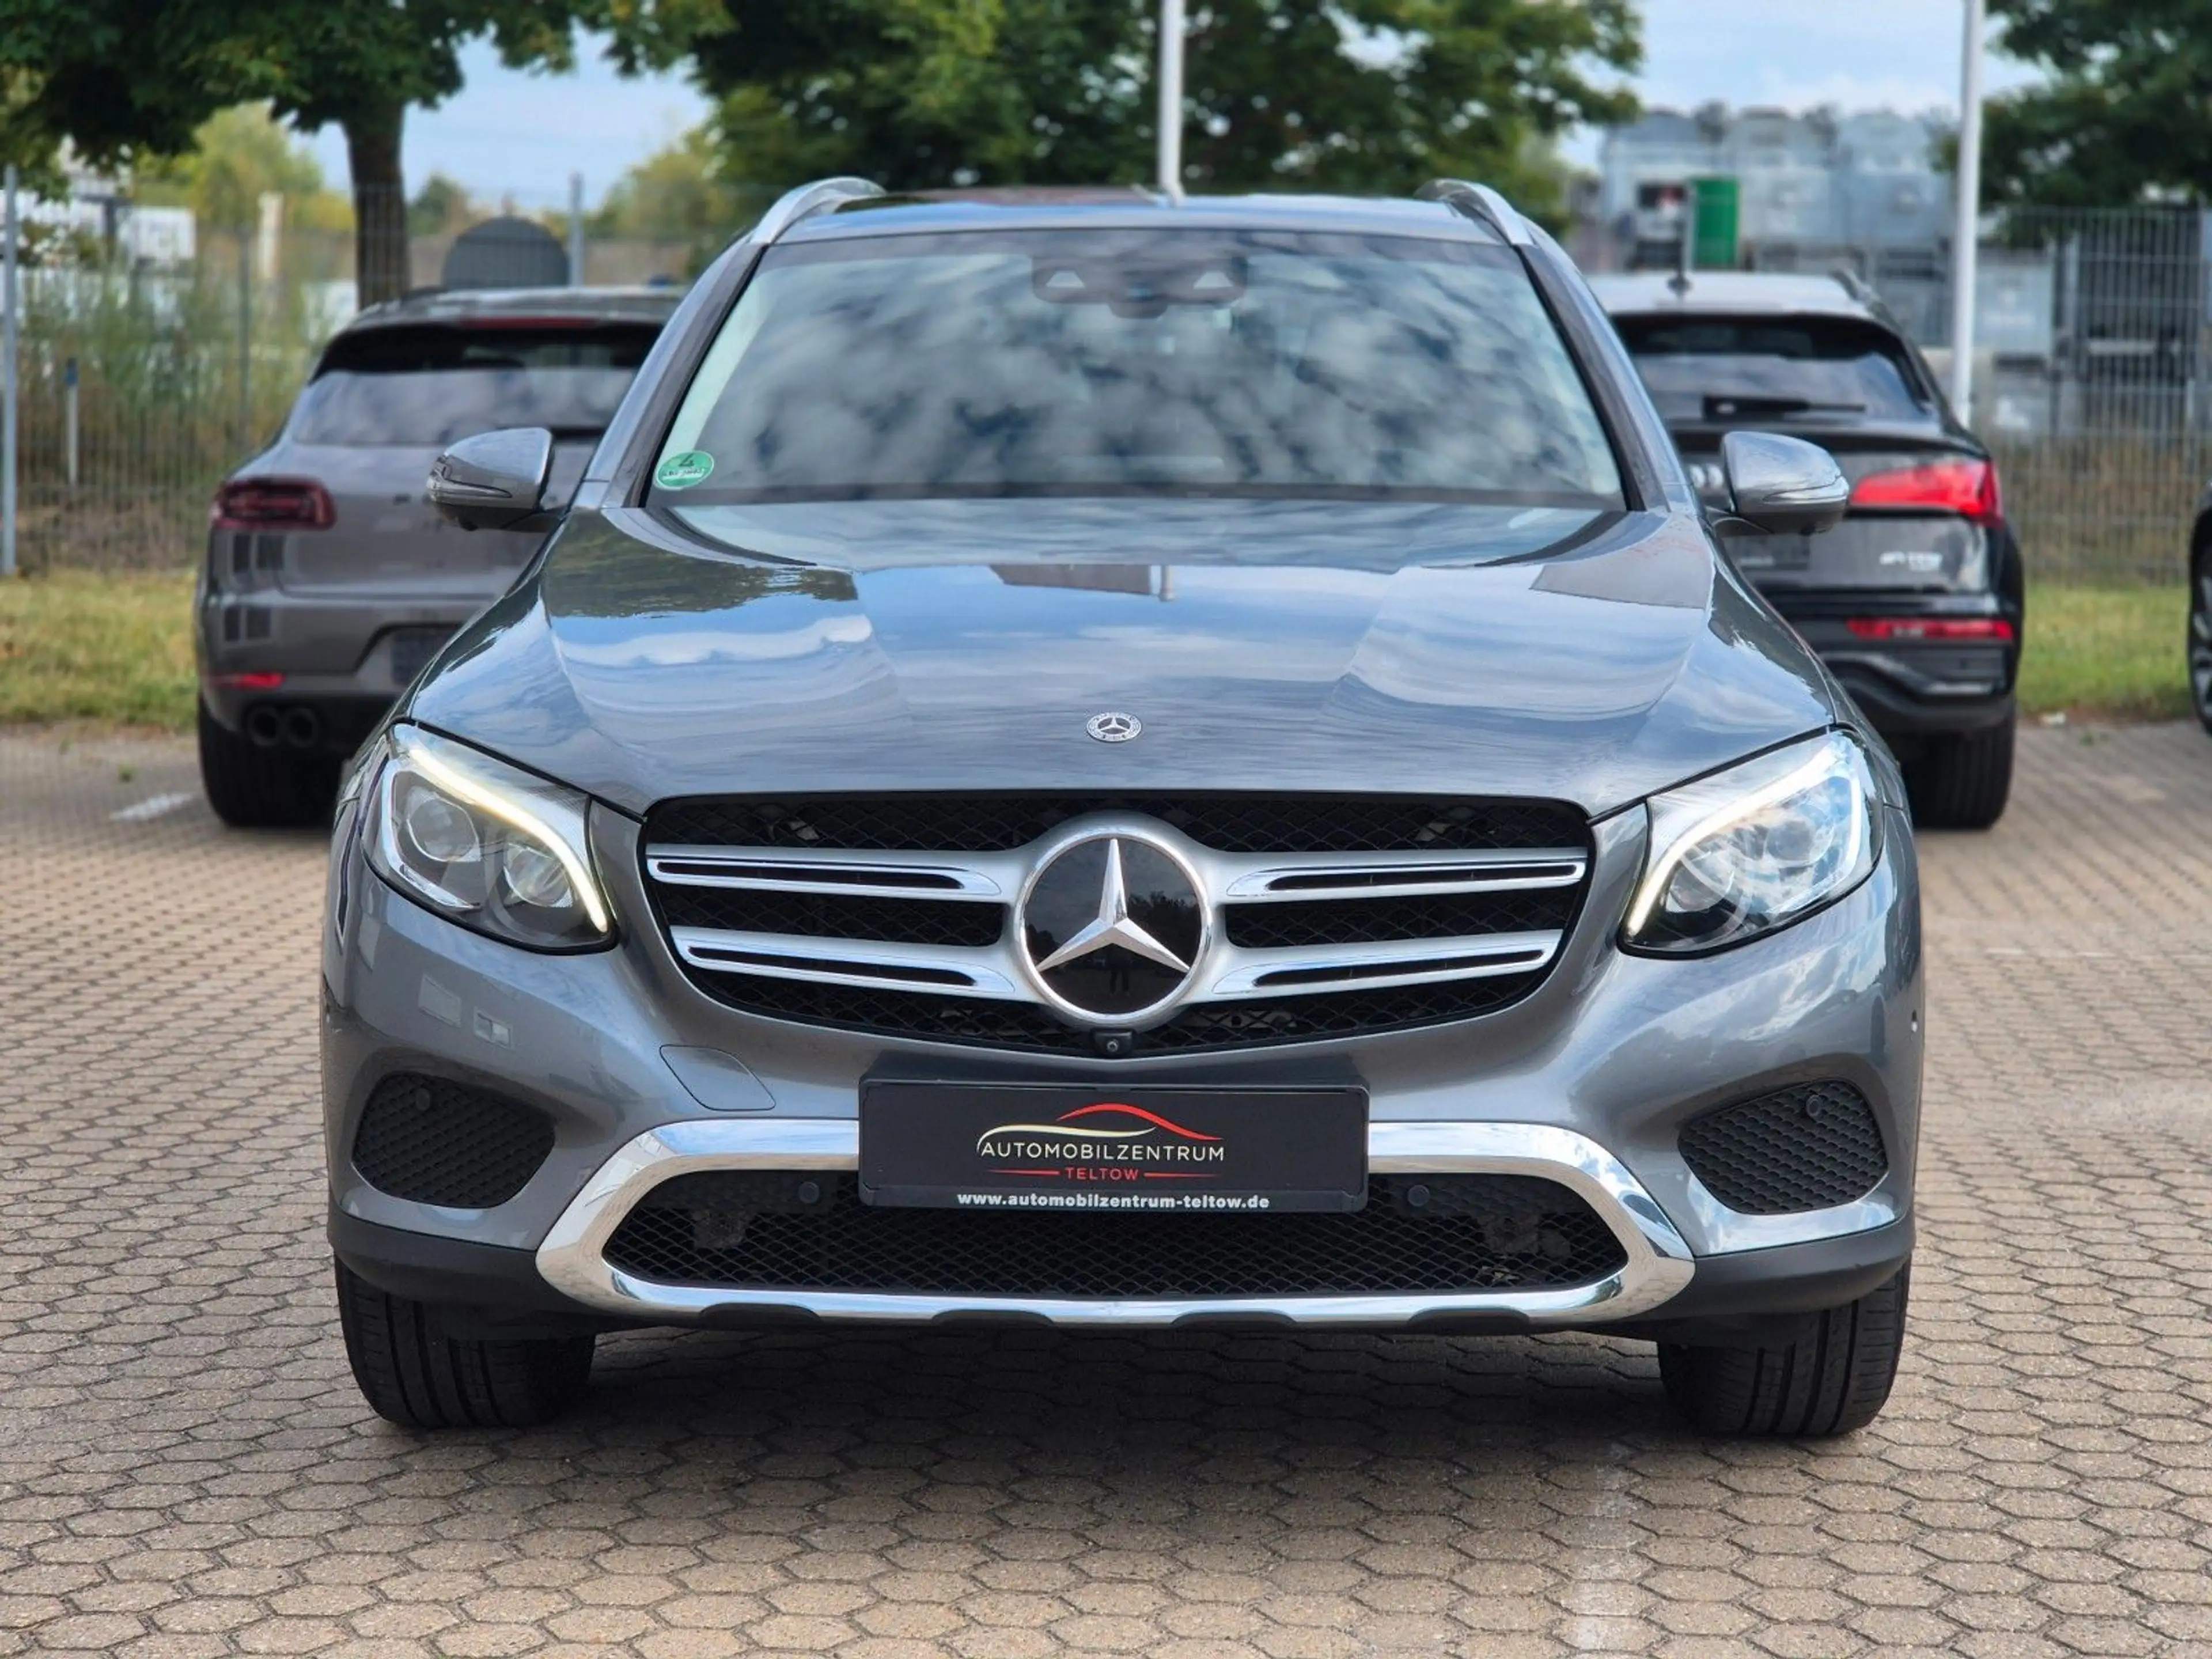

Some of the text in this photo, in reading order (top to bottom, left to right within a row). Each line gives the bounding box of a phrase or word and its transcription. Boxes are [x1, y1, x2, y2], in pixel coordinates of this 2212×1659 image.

[678, 453, 695, 467] 4
[981, 1142, 1225, 1161] AUTOMOBILZENTRUM
[1065, 1167, 1139, 1180] TELTOW
[957, 1192, 1270, 1209] www.automobilzentrum-teltow.de
